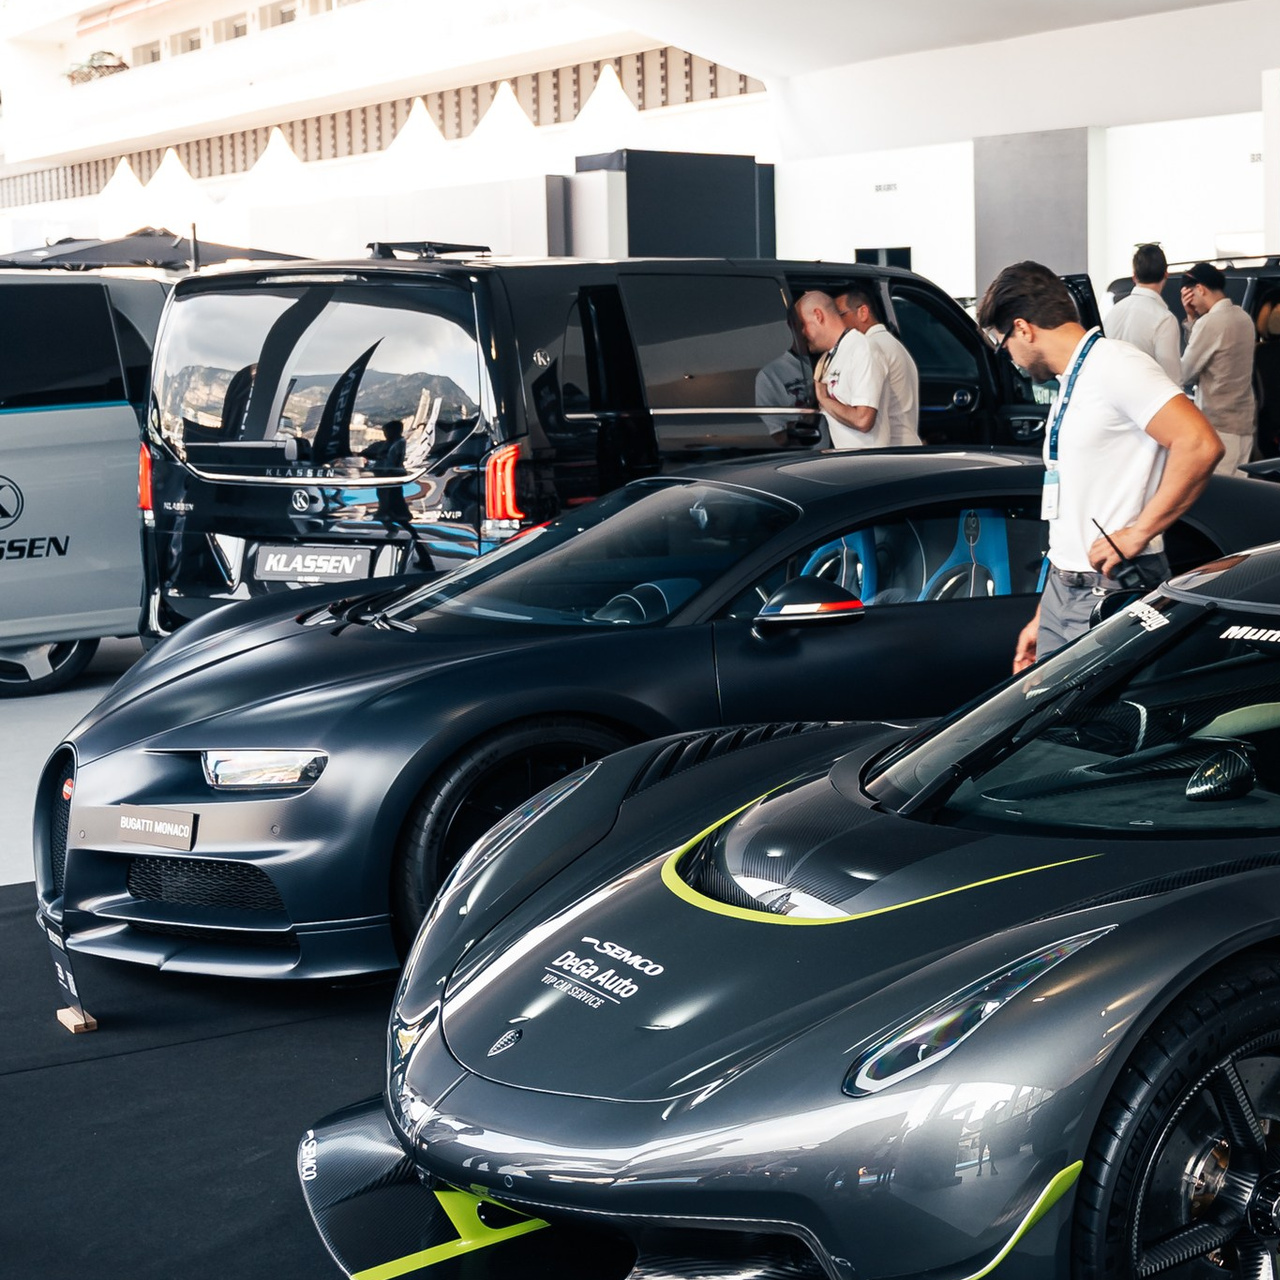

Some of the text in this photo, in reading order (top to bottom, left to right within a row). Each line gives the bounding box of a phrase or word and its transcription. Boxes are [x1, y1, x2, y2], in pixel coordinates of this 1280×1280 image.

[265, 469, 334, 477] KLASSEN
[120, 816, 190, 838] BUGATTI MONACO
[551, 950, 639, 999] DeGa Auto
[581, 936, 664, 976] SEMCO
[540, 973, 605, 1009] VIP CAR SERVICE
[302, 1129, 317, 1180] SEMCO
